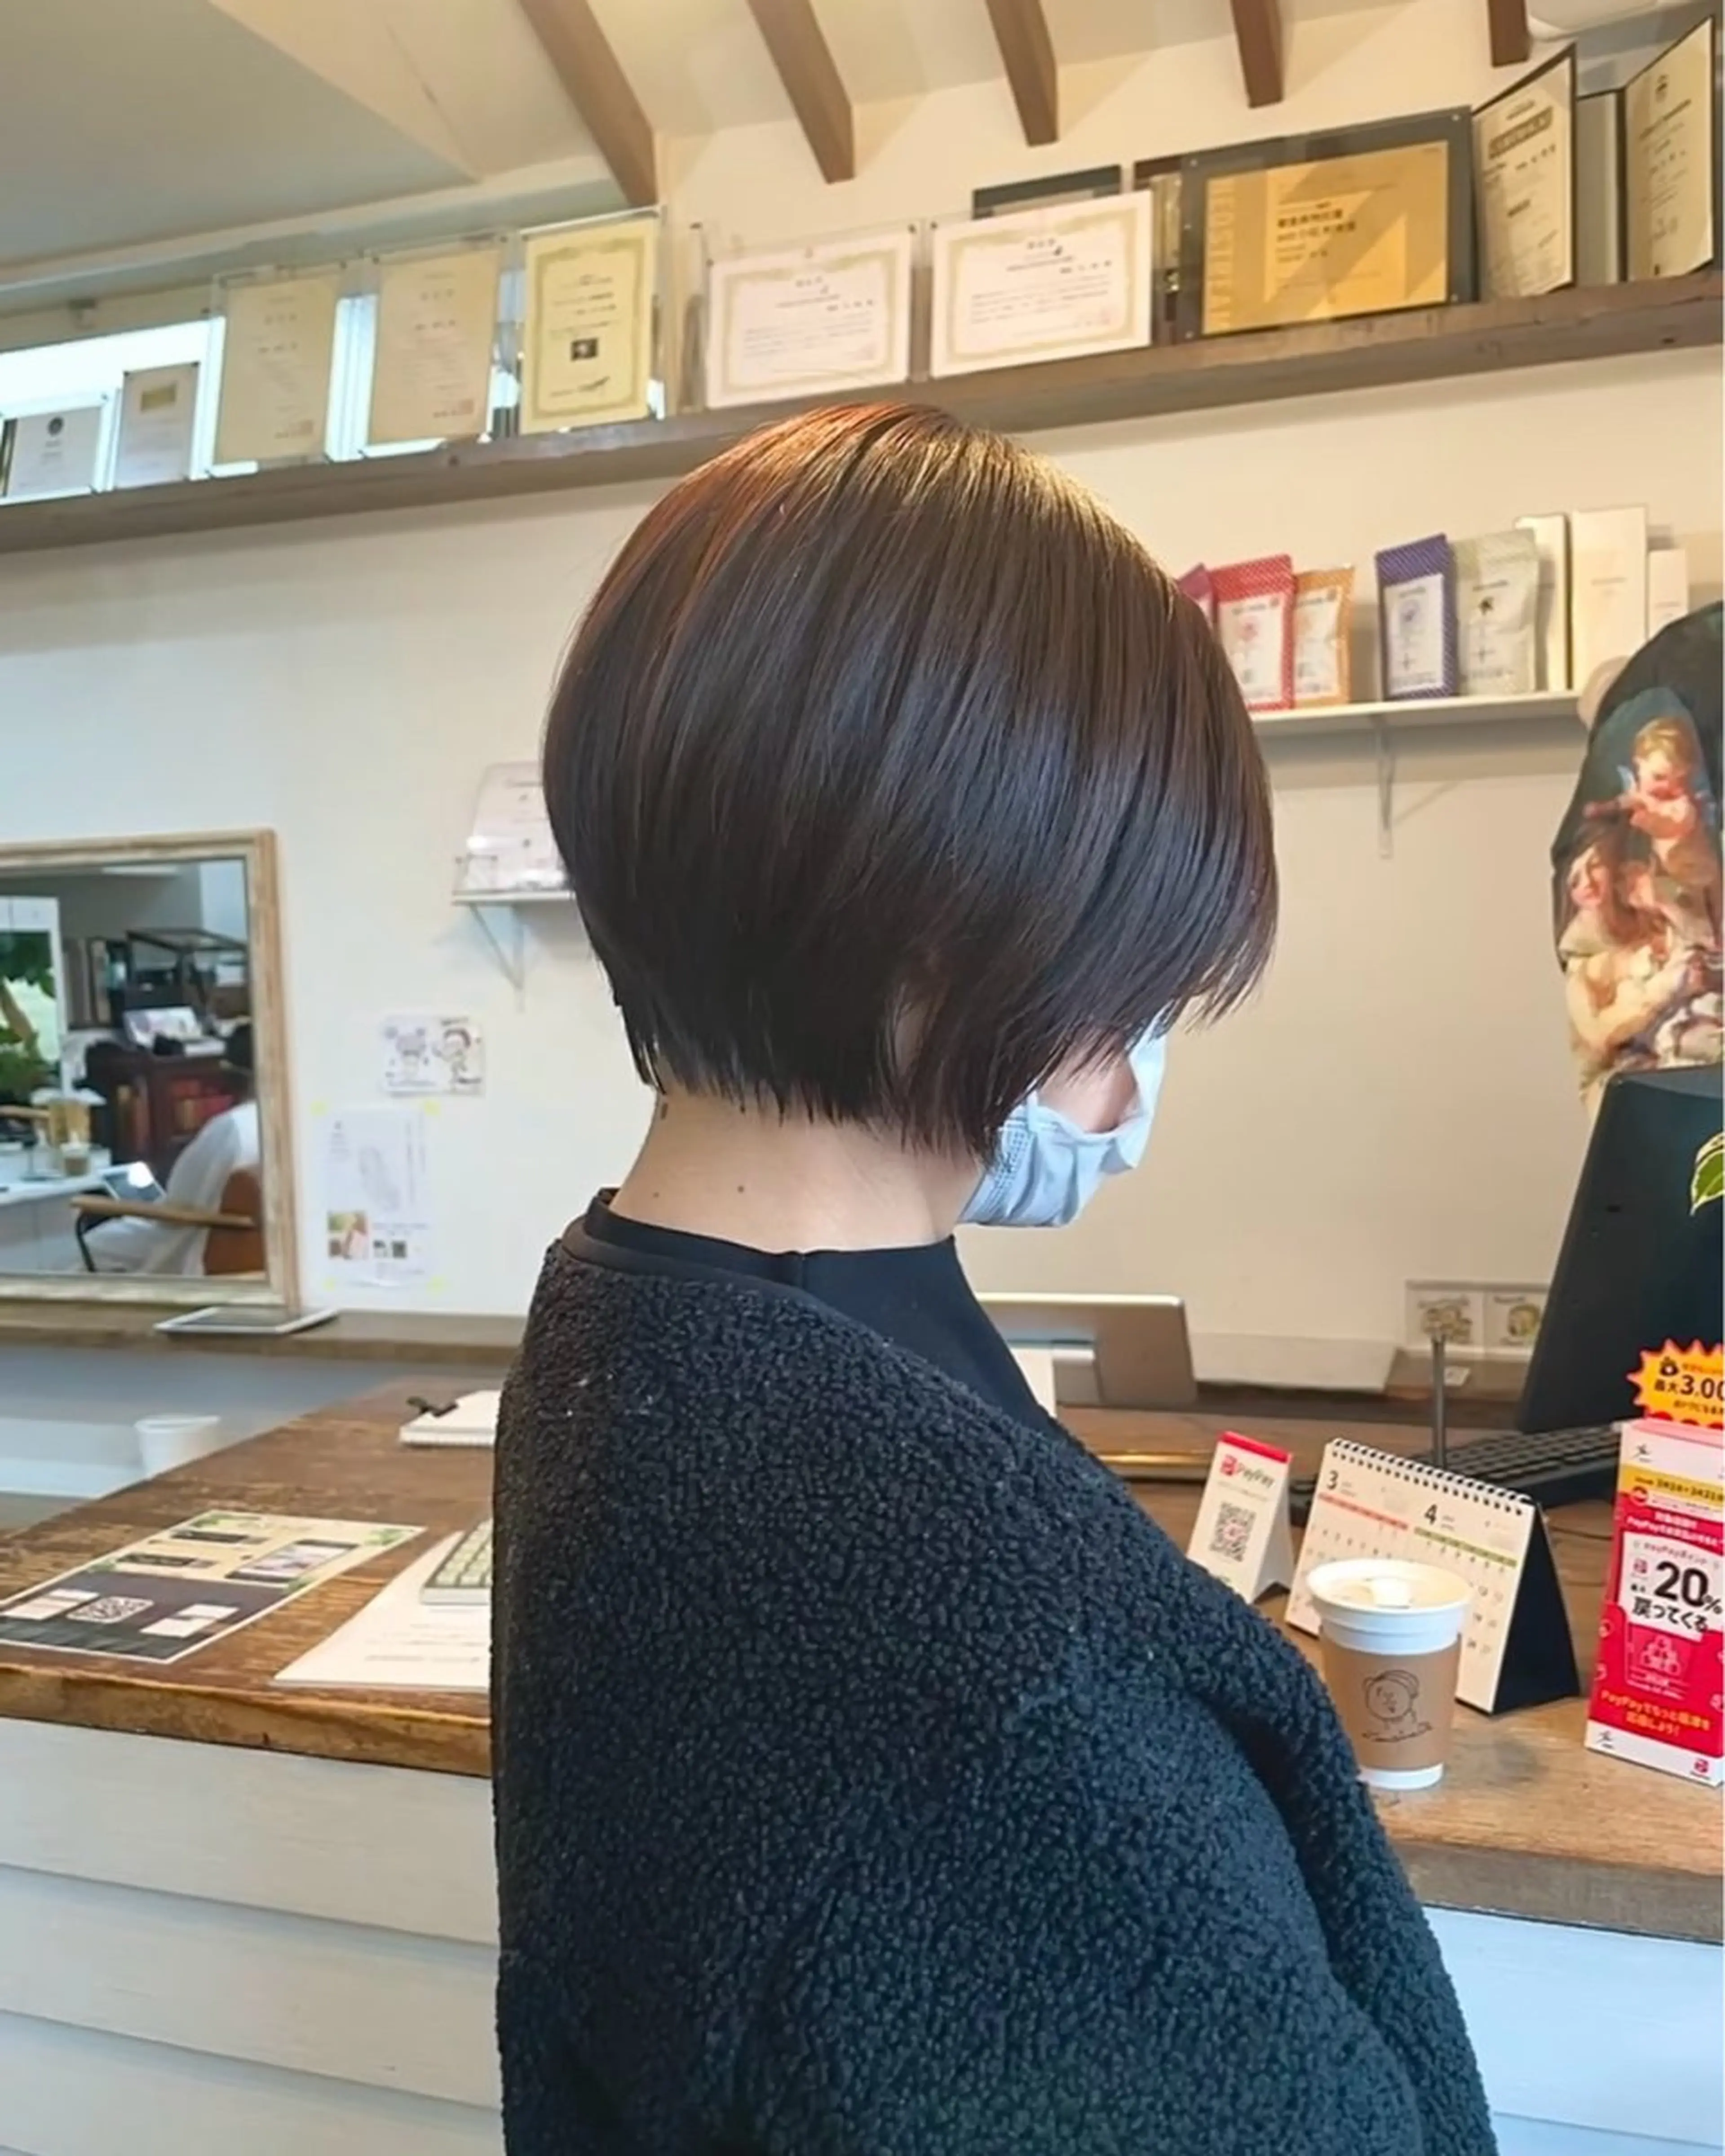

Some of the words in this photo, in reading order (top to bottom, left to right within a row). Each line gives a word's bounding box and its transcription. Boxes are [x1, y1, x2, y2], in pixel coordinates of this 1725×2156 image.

[1327, 1470, 1339, 1490] 3
[1424, 1504, 1437, 1524] 4
[1632, 1597, 1709, 1633] 戻ってくる
